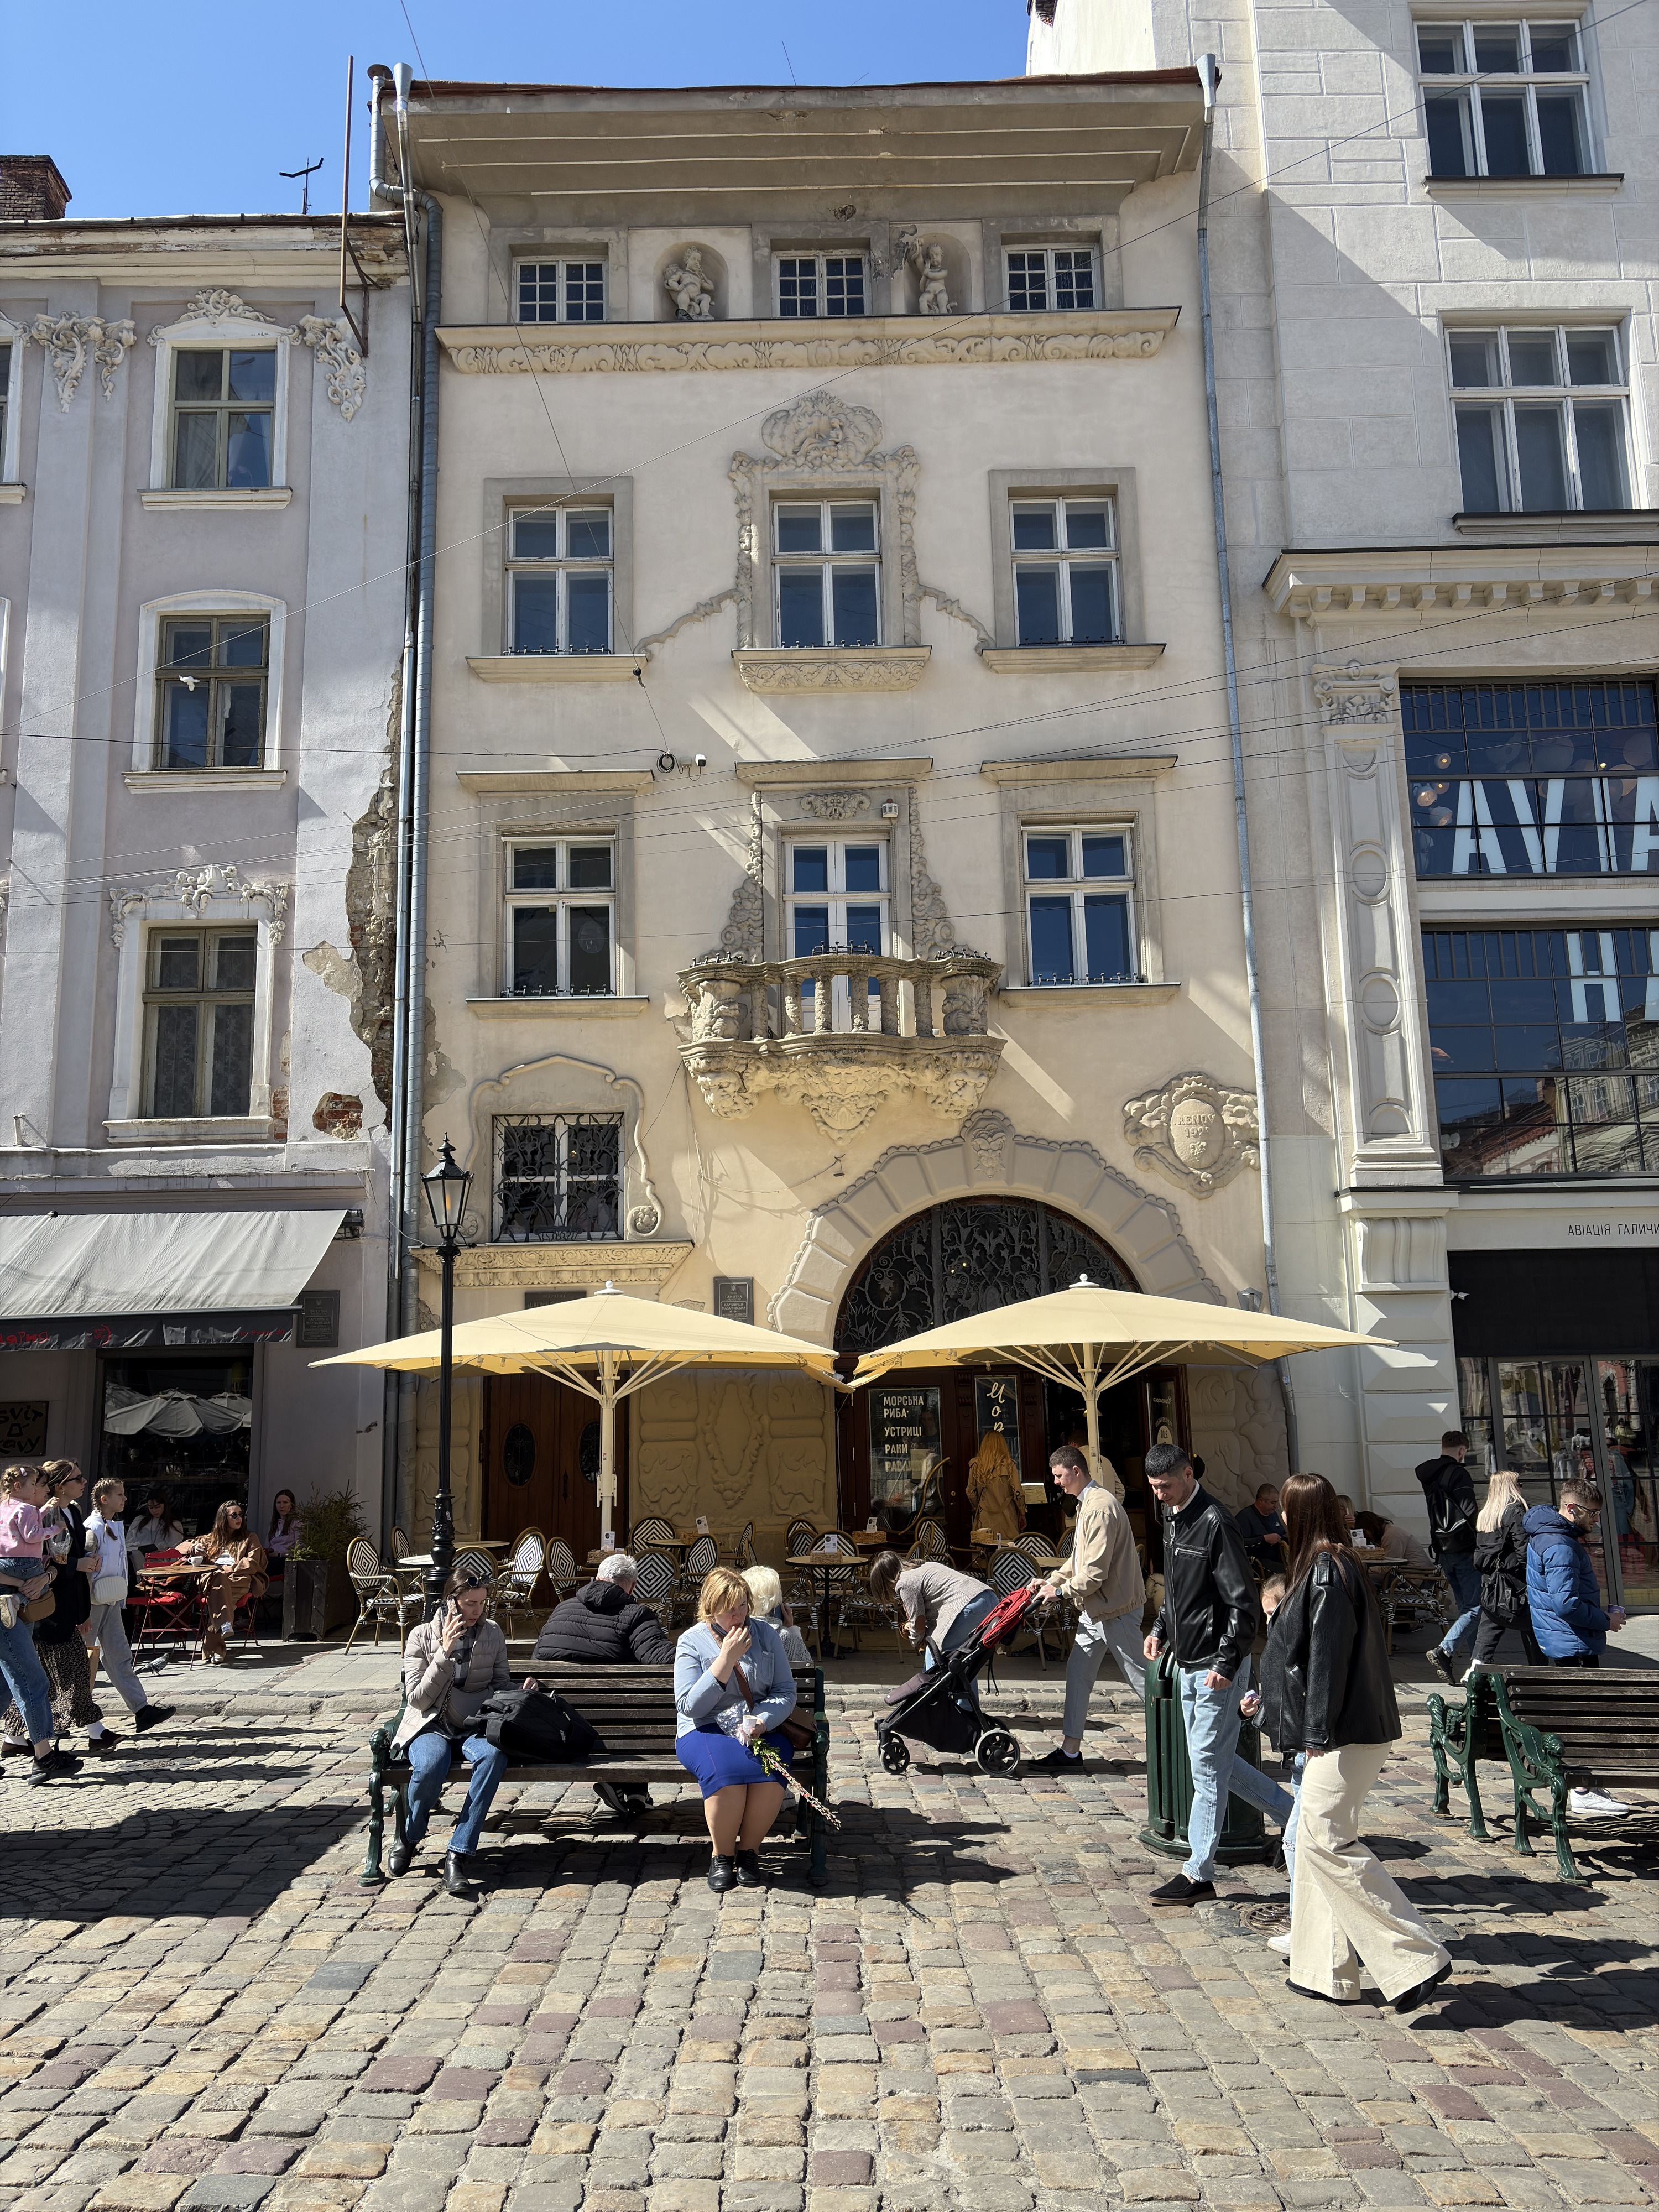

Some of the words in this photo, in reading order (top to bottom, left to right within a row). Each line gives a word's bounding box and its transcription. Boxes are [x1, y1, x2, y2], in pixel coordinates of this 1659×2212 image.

[1567, 932, 1659, 1022] H
[1568, 1224, 1611, 1237] АВІАЦІЯ
[883, 1395, 924, 1406] МОРСЬКА
[884, 1408, 907, 1418] РИБА
[884, 1426, 922, 1437] УСТРИЦІ
[885, 1444, 907, 1454] РАКИ
